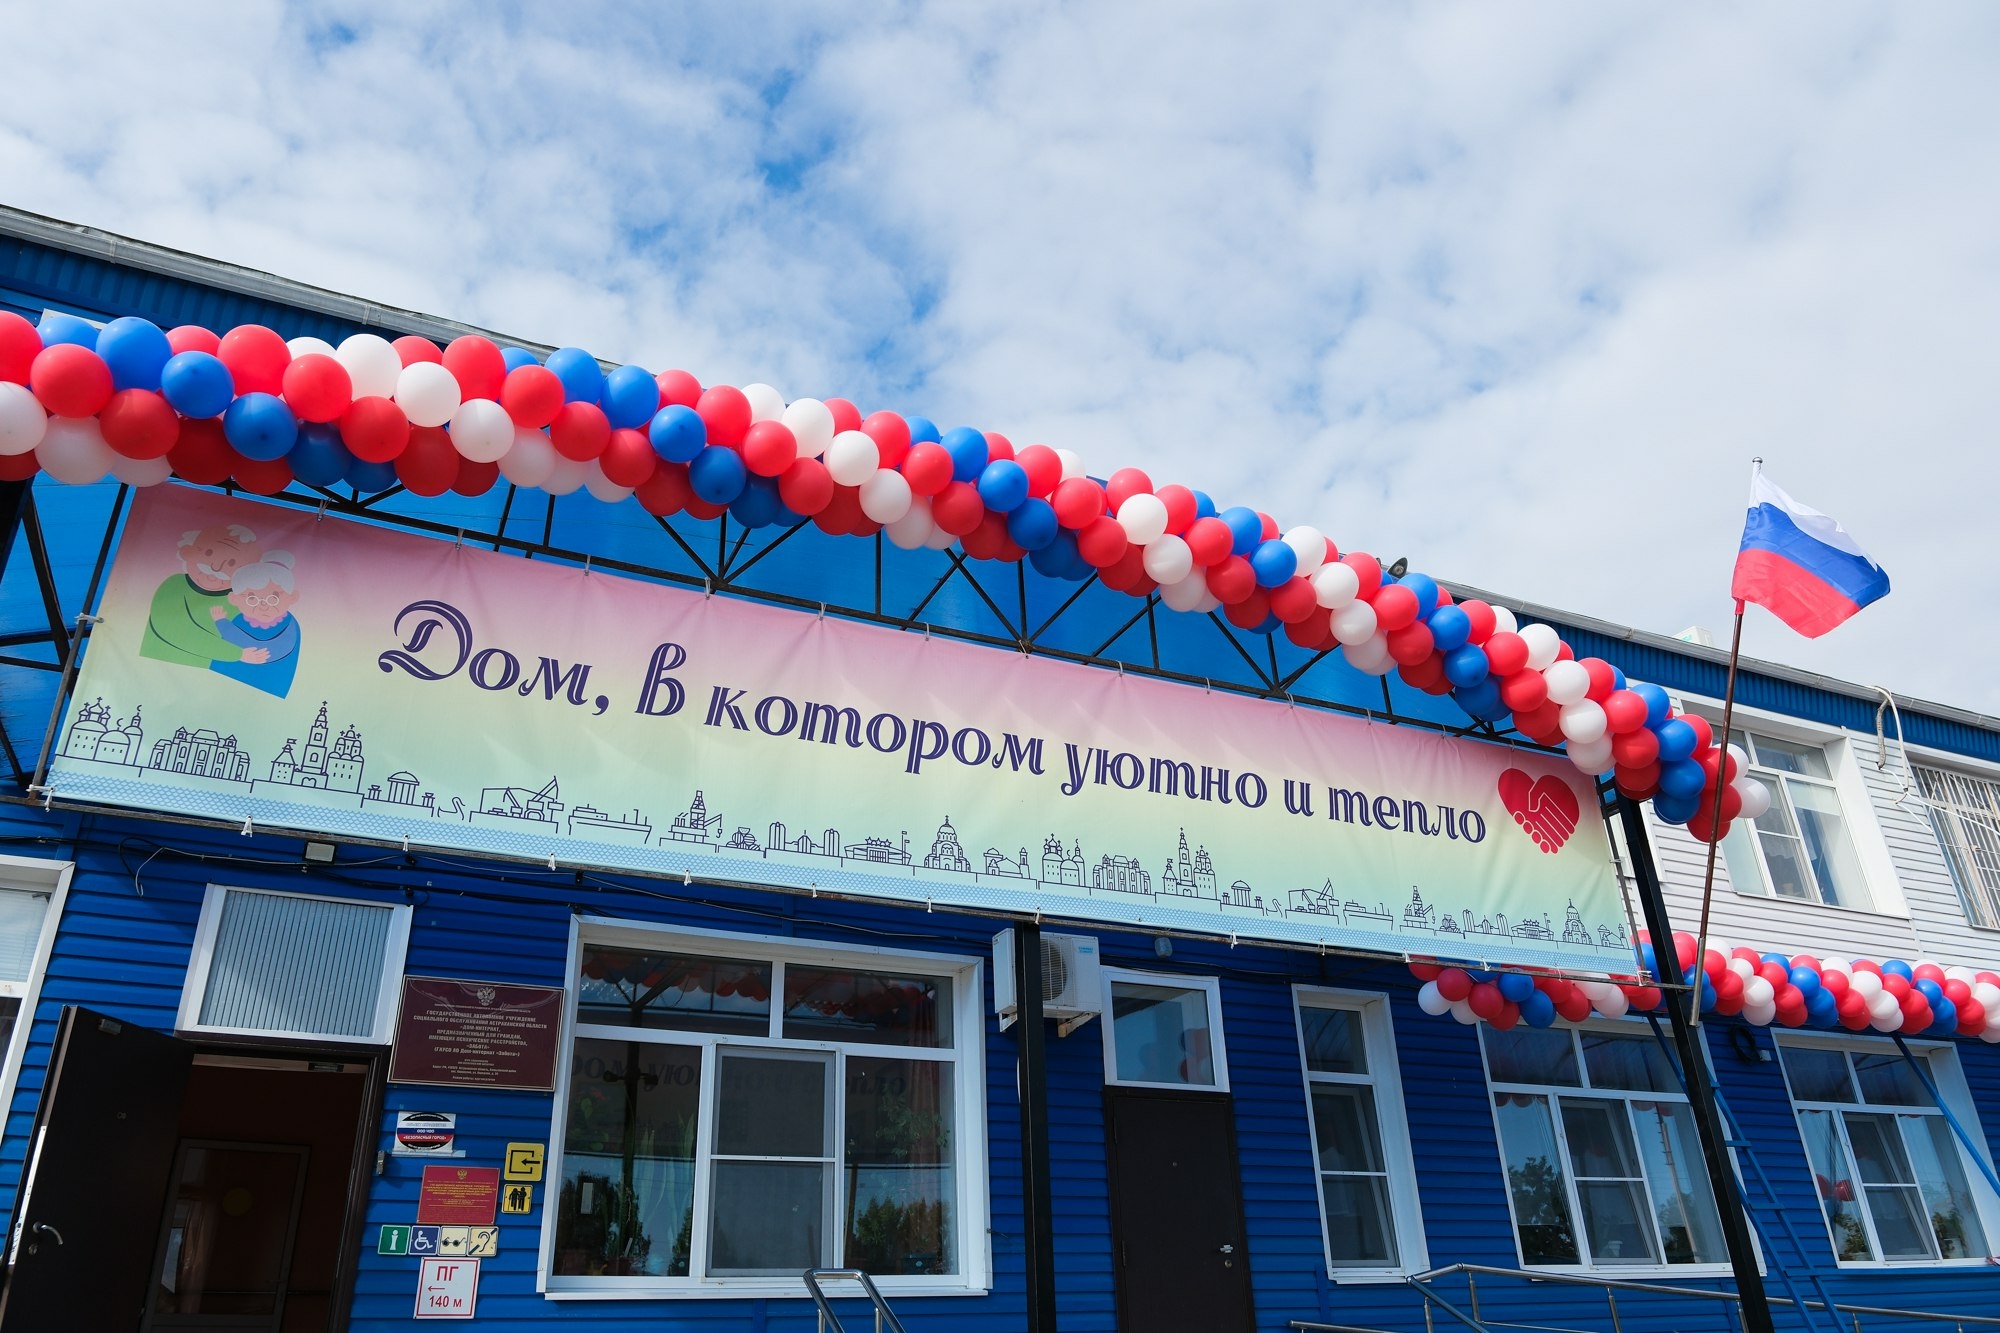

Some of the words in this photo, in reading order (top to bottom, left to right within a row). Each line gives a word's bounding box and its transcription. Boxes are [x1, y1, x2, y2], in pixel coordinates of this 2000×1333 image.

[378, 600, 609, 716] Дом,
[704, 686, 1045, 775] котором
[1061, 742, 1267, 809] уютно
[1283, 779, 1315, 818] и
[1328, 785, 1487, 844] тепло
[413, 1015, 449, 1023] СОЦИАЛЬНОГО
[489, 1020, 526, 1028] АСТРАХАНСКОЙ
[426, 1010, 472, 1019] ГОСУДАРСТВЕННОЕ
[505, 1015, 536, 1023] УЧРЕЖДЕНИЕ
[436, 1265, 459, 1281] ПГ
[429, 1295, 449, 1308] 140
[453, 1298, 462, 1308] м
